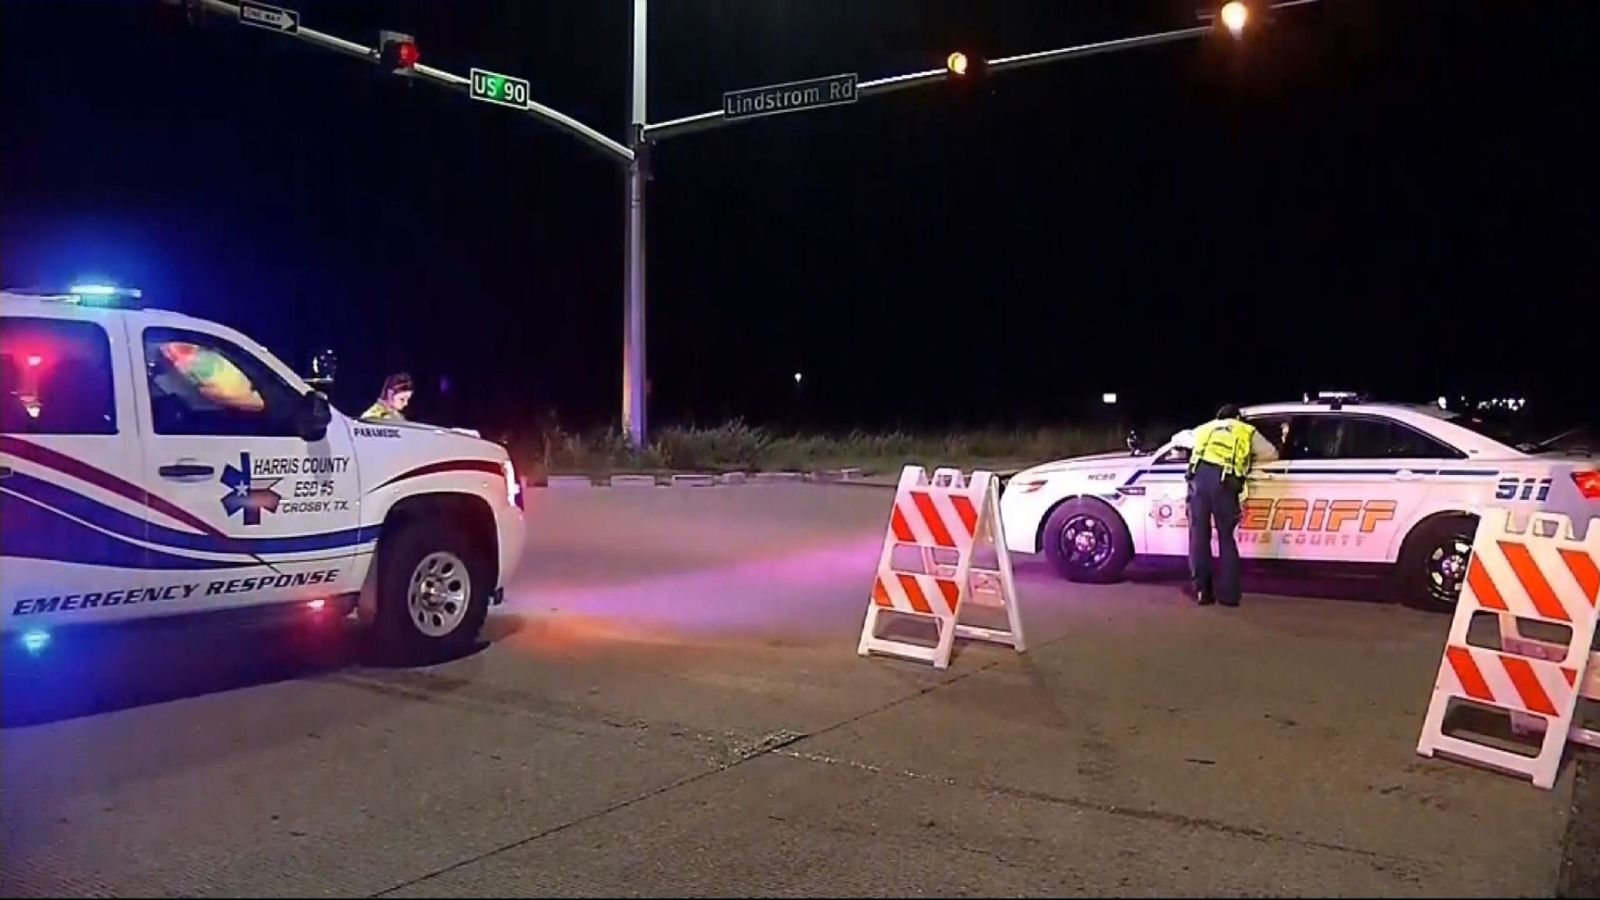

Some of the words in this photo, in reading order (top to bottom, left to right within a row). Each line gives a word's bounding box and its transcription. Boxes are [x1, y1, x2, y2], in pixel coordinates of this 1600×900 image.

[475, 75, 497, 97] US
[504, 82, 525, 102] 90
[727, 87, 819, 114] Lindstrom
[830, 79, 853, 100] Rd
[354, 427, 401, 438] PARAMEDIC
[253, 458, 299, 475] HARRIS
[302, 456, 350, 474] COUNTY
[294, 480, 319, 498] ESD
[320, 480, 334, 497] #5
[1496, 478, 1553, 501] 911
[282, 501, 330, 514] CROSBY,
[1239, 498, 1398, 532] ERIFF
[12, 583, 200, 616] EMERGENCY
[205, 569, 341, 596] RESPONSE
